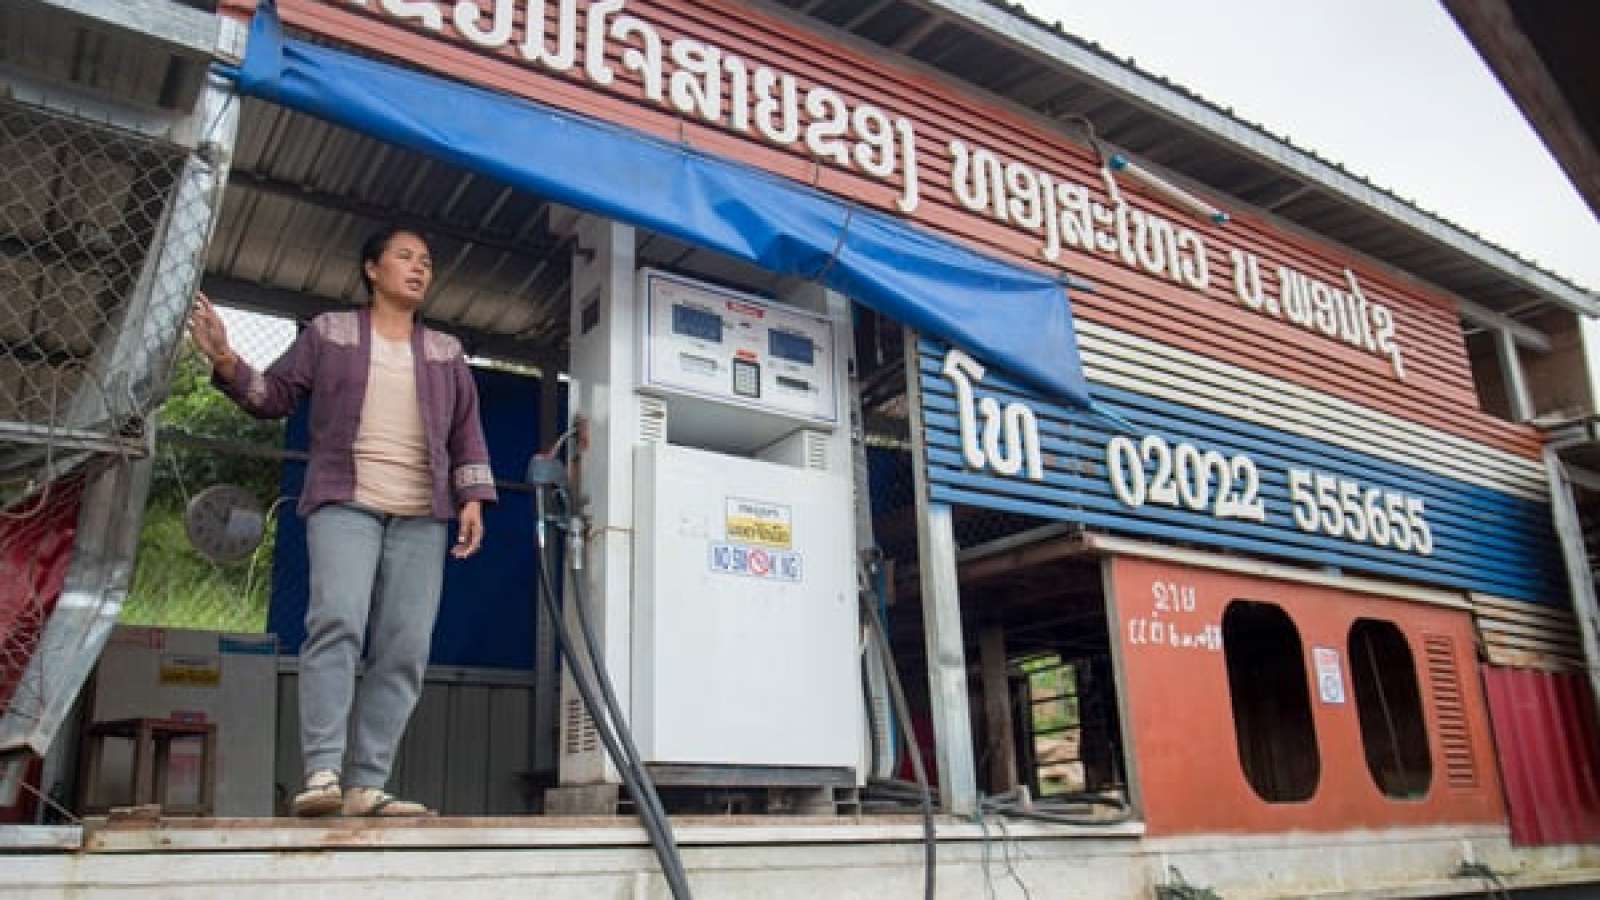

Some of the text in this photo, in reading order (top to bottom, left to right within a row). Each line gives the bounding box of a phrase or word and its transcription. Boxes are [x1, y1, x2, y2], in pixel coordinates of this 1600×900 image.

[944, 350, 1433, 555] ໂທ 02022 555655
